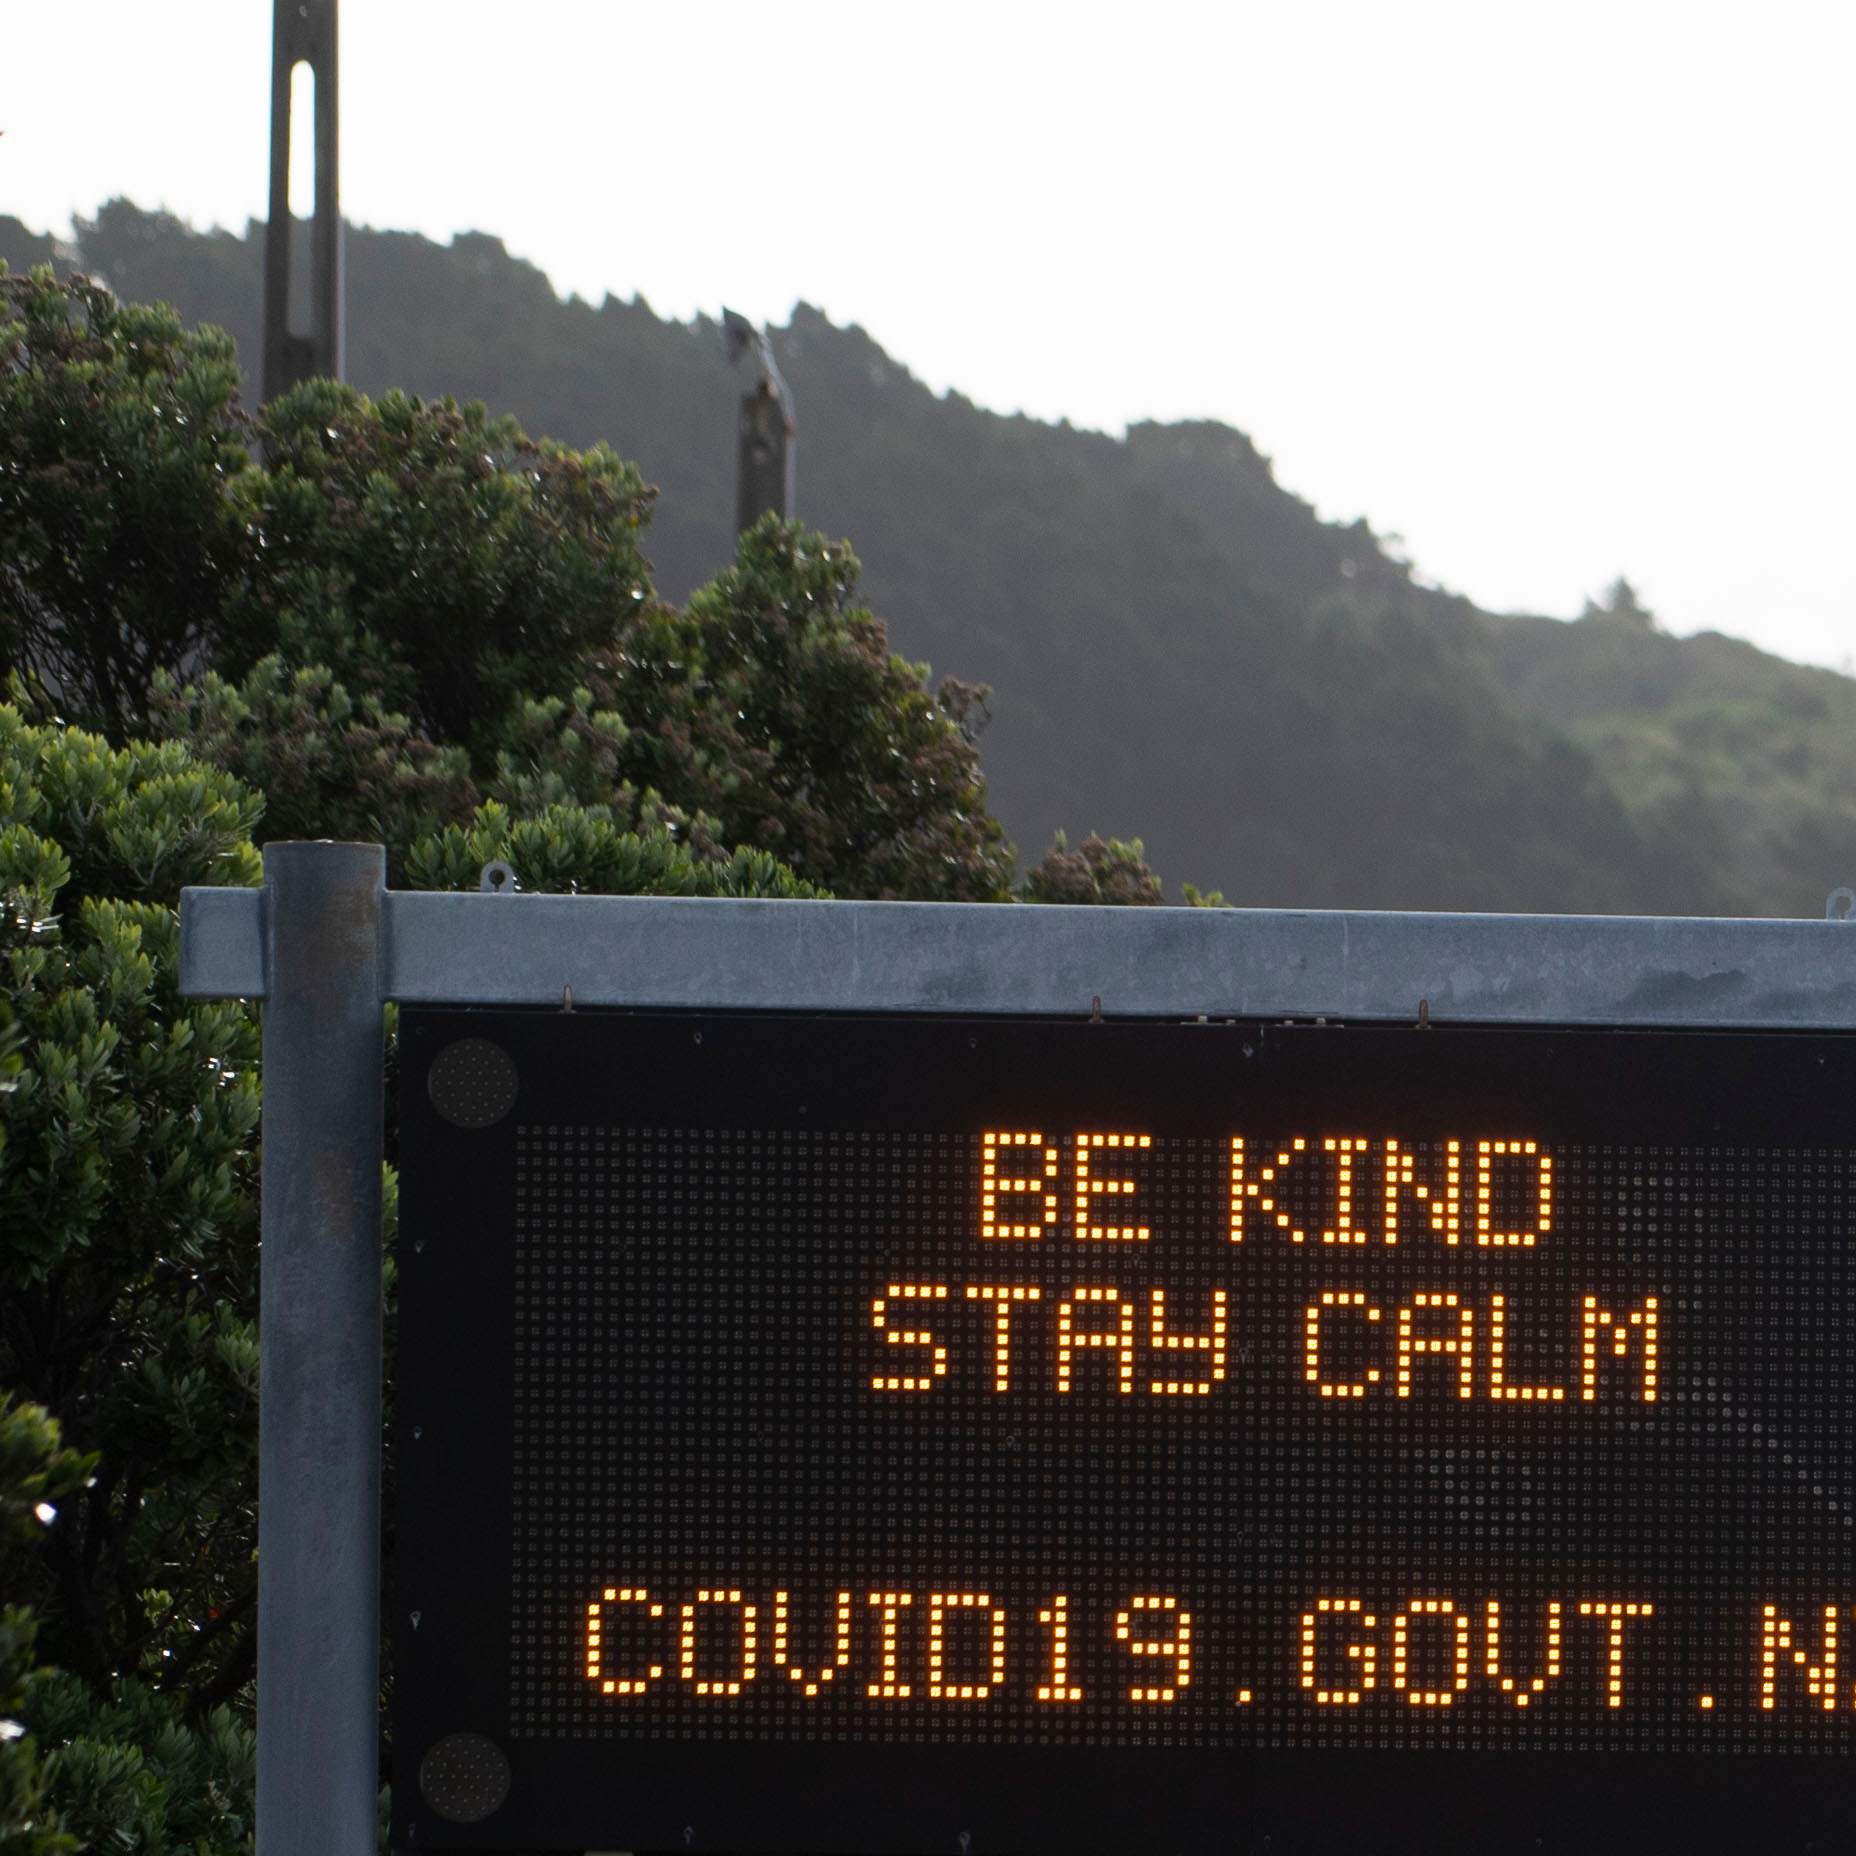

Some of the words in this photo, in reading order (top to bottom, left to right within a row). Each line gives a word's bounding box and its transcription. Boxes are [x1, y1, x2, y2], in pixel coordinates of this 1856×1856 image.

[981, 1131, 1151, 1240] BE
[1229, 1136, 1553, 1246] KIND
[871, 1284, 1226, 1394] STAY
[1305, 1291, 1658, 1402] CALM
